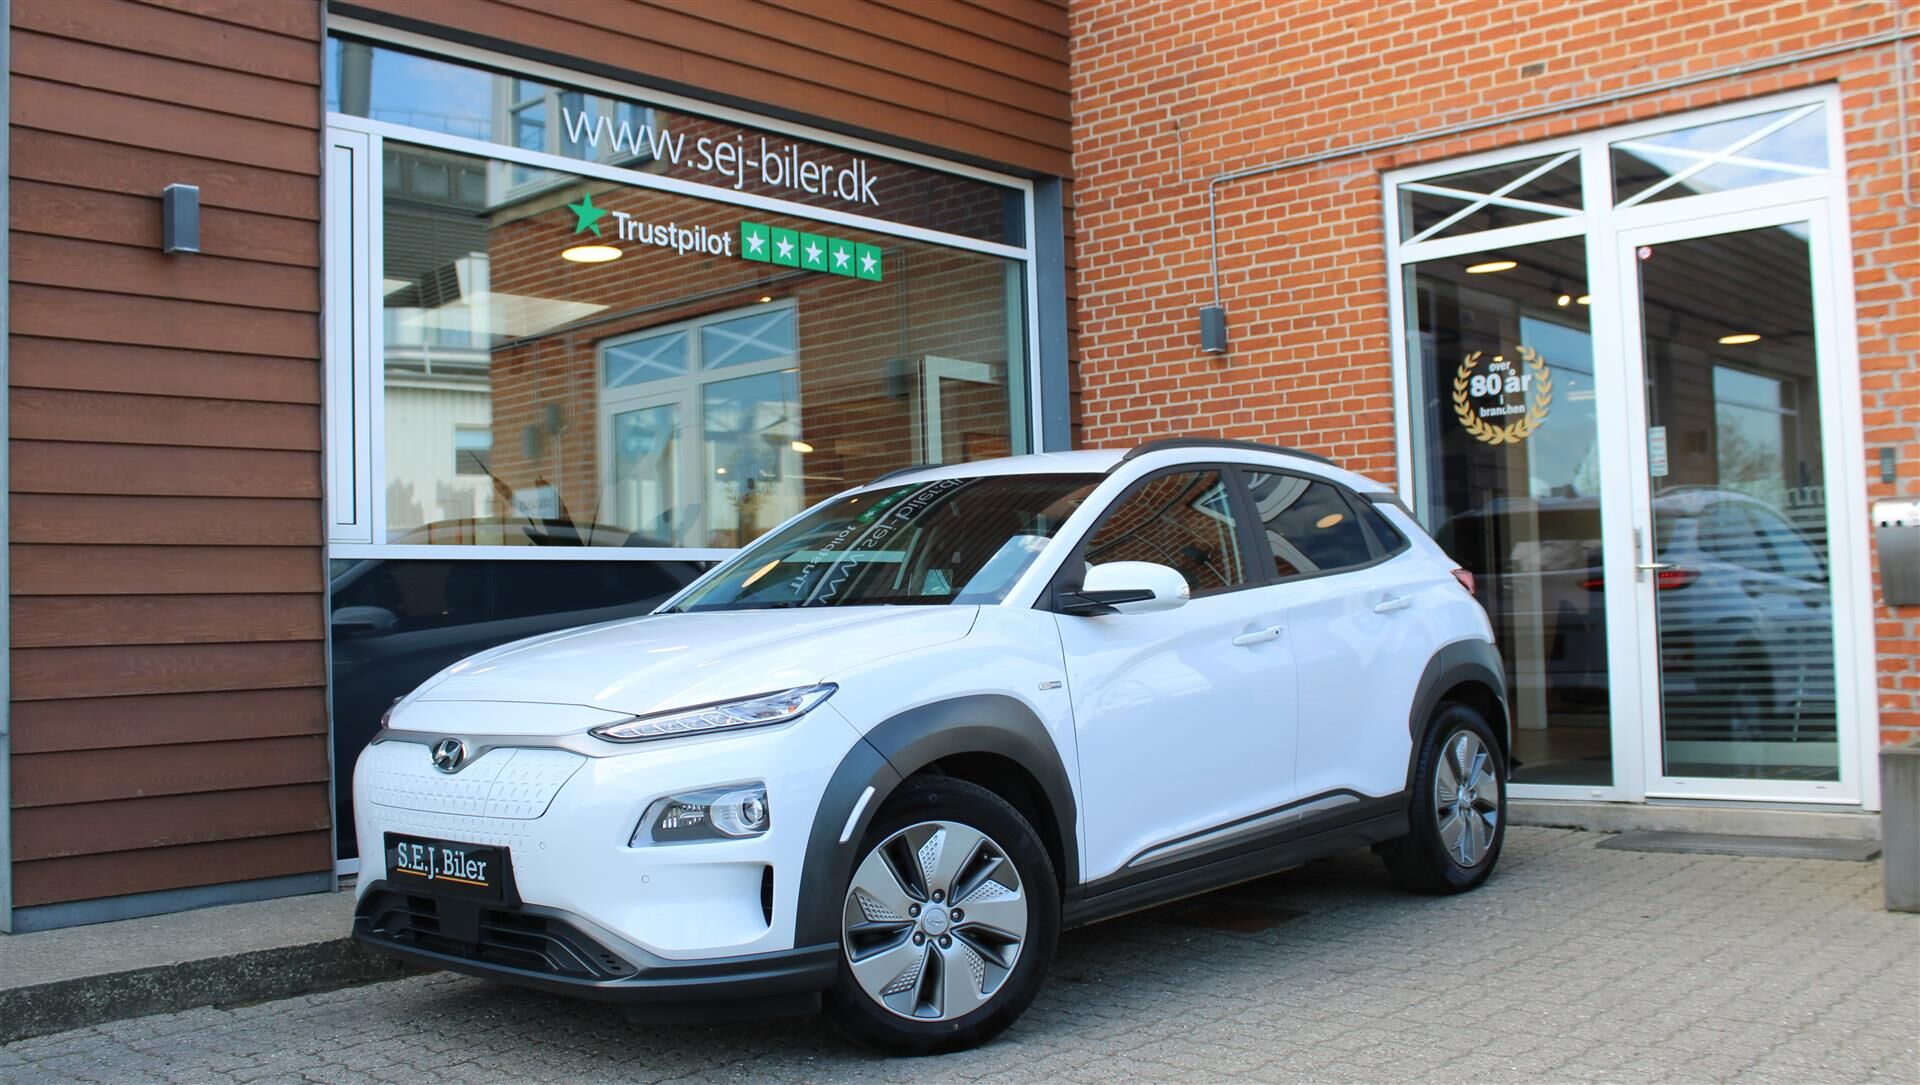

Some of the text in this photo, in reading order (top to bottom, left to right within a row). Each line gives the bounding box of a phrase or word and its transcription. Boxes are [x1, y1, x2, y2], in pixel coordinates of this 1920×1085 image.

[562, 107, 879, 206] www.sej-biler.dk
[612, 211, 732, 256] Trustpilot
[1489, 361, 1511, 371] over
[1470, 369, 1532, 397] 80 år
[1480, 404, 1525, 416] branchen
[398, 842, 487, 881] S.E.J. Biler
